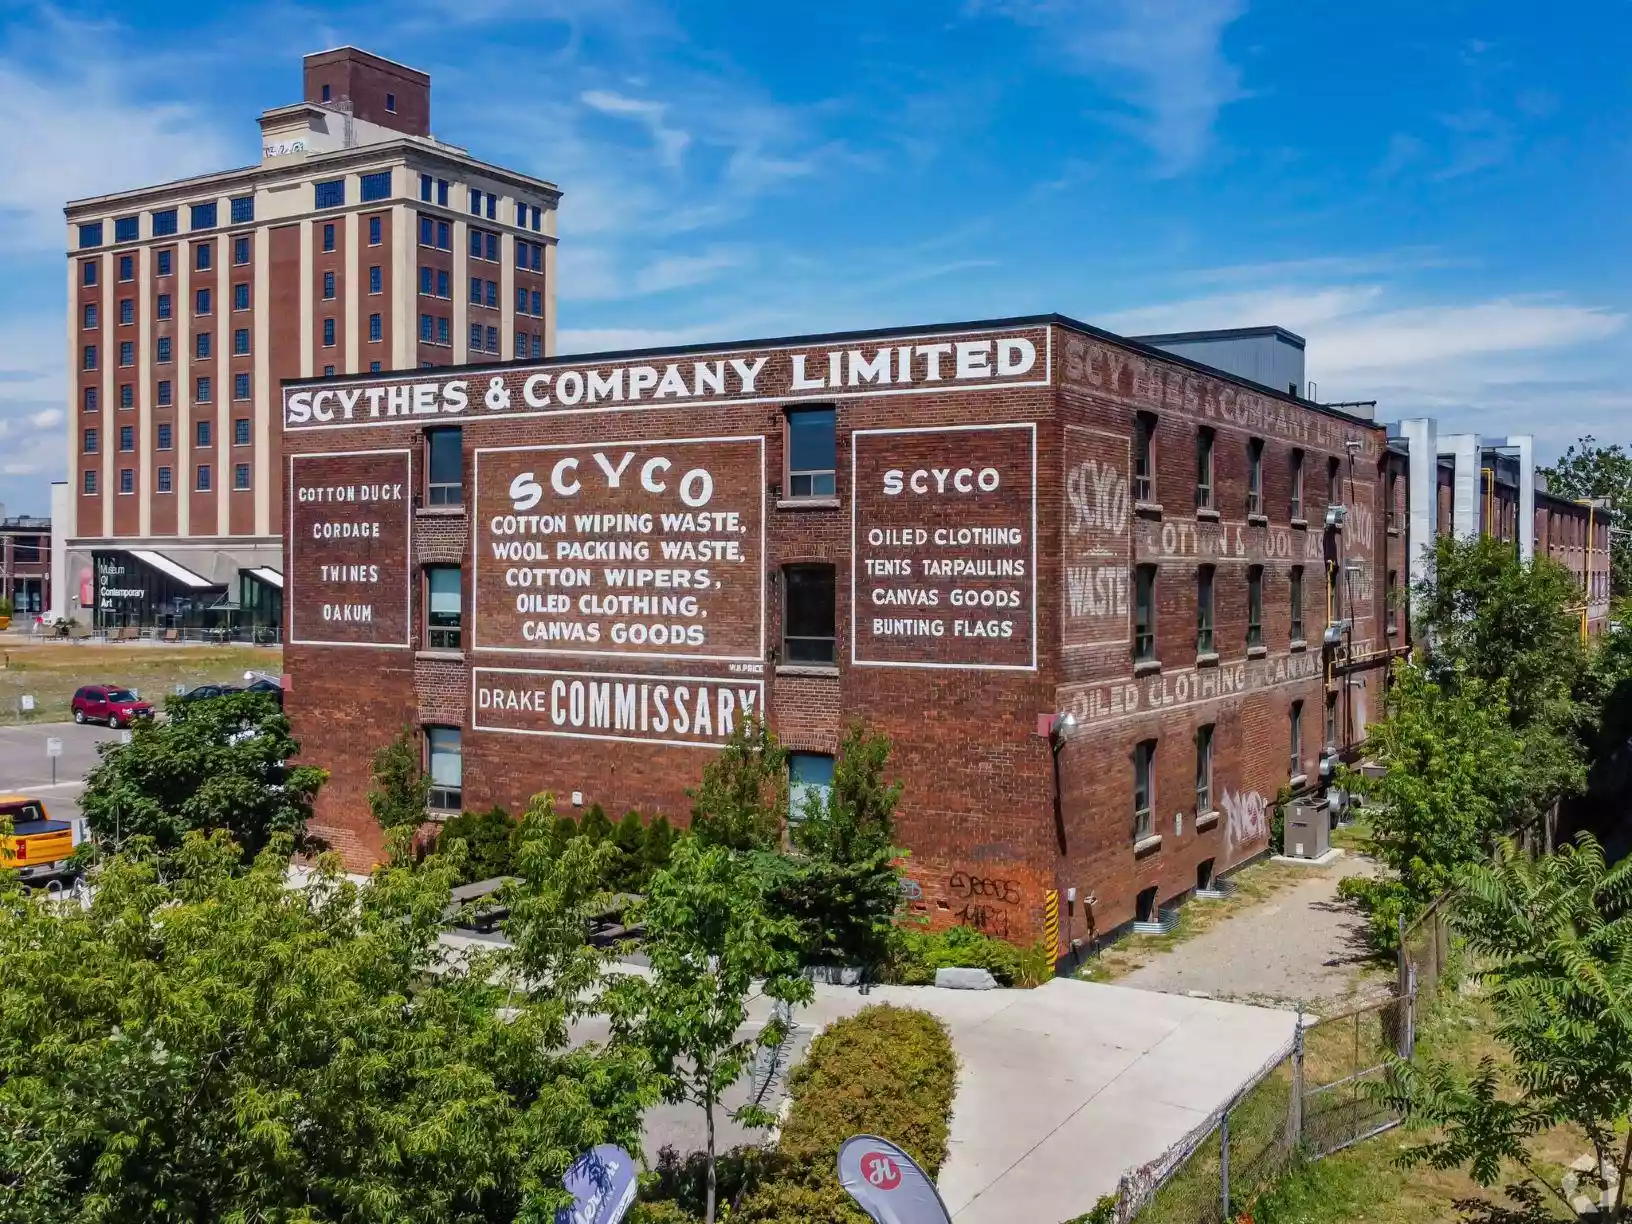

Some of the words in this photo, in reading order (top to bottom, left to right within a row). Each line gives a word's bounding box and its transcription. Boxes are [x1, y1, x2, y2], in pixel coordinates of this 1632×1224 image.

[288, 380, 468, 423] SCYTHES
[484, 376, 511, 411] &
[523, 357, 769, 408] COMPANY
[790, 337, 1036, 391] LIMITED
[509, 451, 714, 511] SCYCO
[883, 467, 1000, 495] SCYCO
[299, 487, 355, 502] COTTON
[361, 484, 402, 501] DUCK
[313, 522, 380, 539] CORDAGE
[491, 515, 566, 535] COTTON
[573, 513, 653, 534] WIPING
[659, 512, 747, 534] WASTE,
[868, 529, 928, 545] OILED
[934, 528, 1022, 545] CLOTHING
[492, 542, 548, 561] WOOL
[556, 542, 650, 561] PACKING
[660, 541, 746, 563] WASTE,
[100, 564, 125, 574] Museum
[321, 565, 378, 582] TWINES
[505, 568, 591, 588] COTTON
[604, 569, 722, 590] WIPERS,
[865, 560, 911, 575] TENTS
[923, 560, 1025, 576] TARPAULINS
[100, 586, 145, 599] Contemporary
[100, 597, 113, 608] Art
[872, 588, 939, 605] CANVAS
[950, 590, 1021, 607] GOODS
[1067, 567, 1128, 617] WASTE
[323, 604, 371, 622] OAKUM
[516, 593, 571, 613] OILED
[578, 595, 708, 618] CLOTHING,
[522, 620, 600, 642] CANVAS
[611, 623, 705, 646] GOODS
[873, 618, 944, 636] BUNTING
[954, 620, 1013, 637] FLAGS
[1148, 663, 1246, 707] CLOTHING
[479, 688, 546, 712] DRAKE
[551, 679, 757, 738] COMMISSARY
[869, 1158, 896, 1185] H
